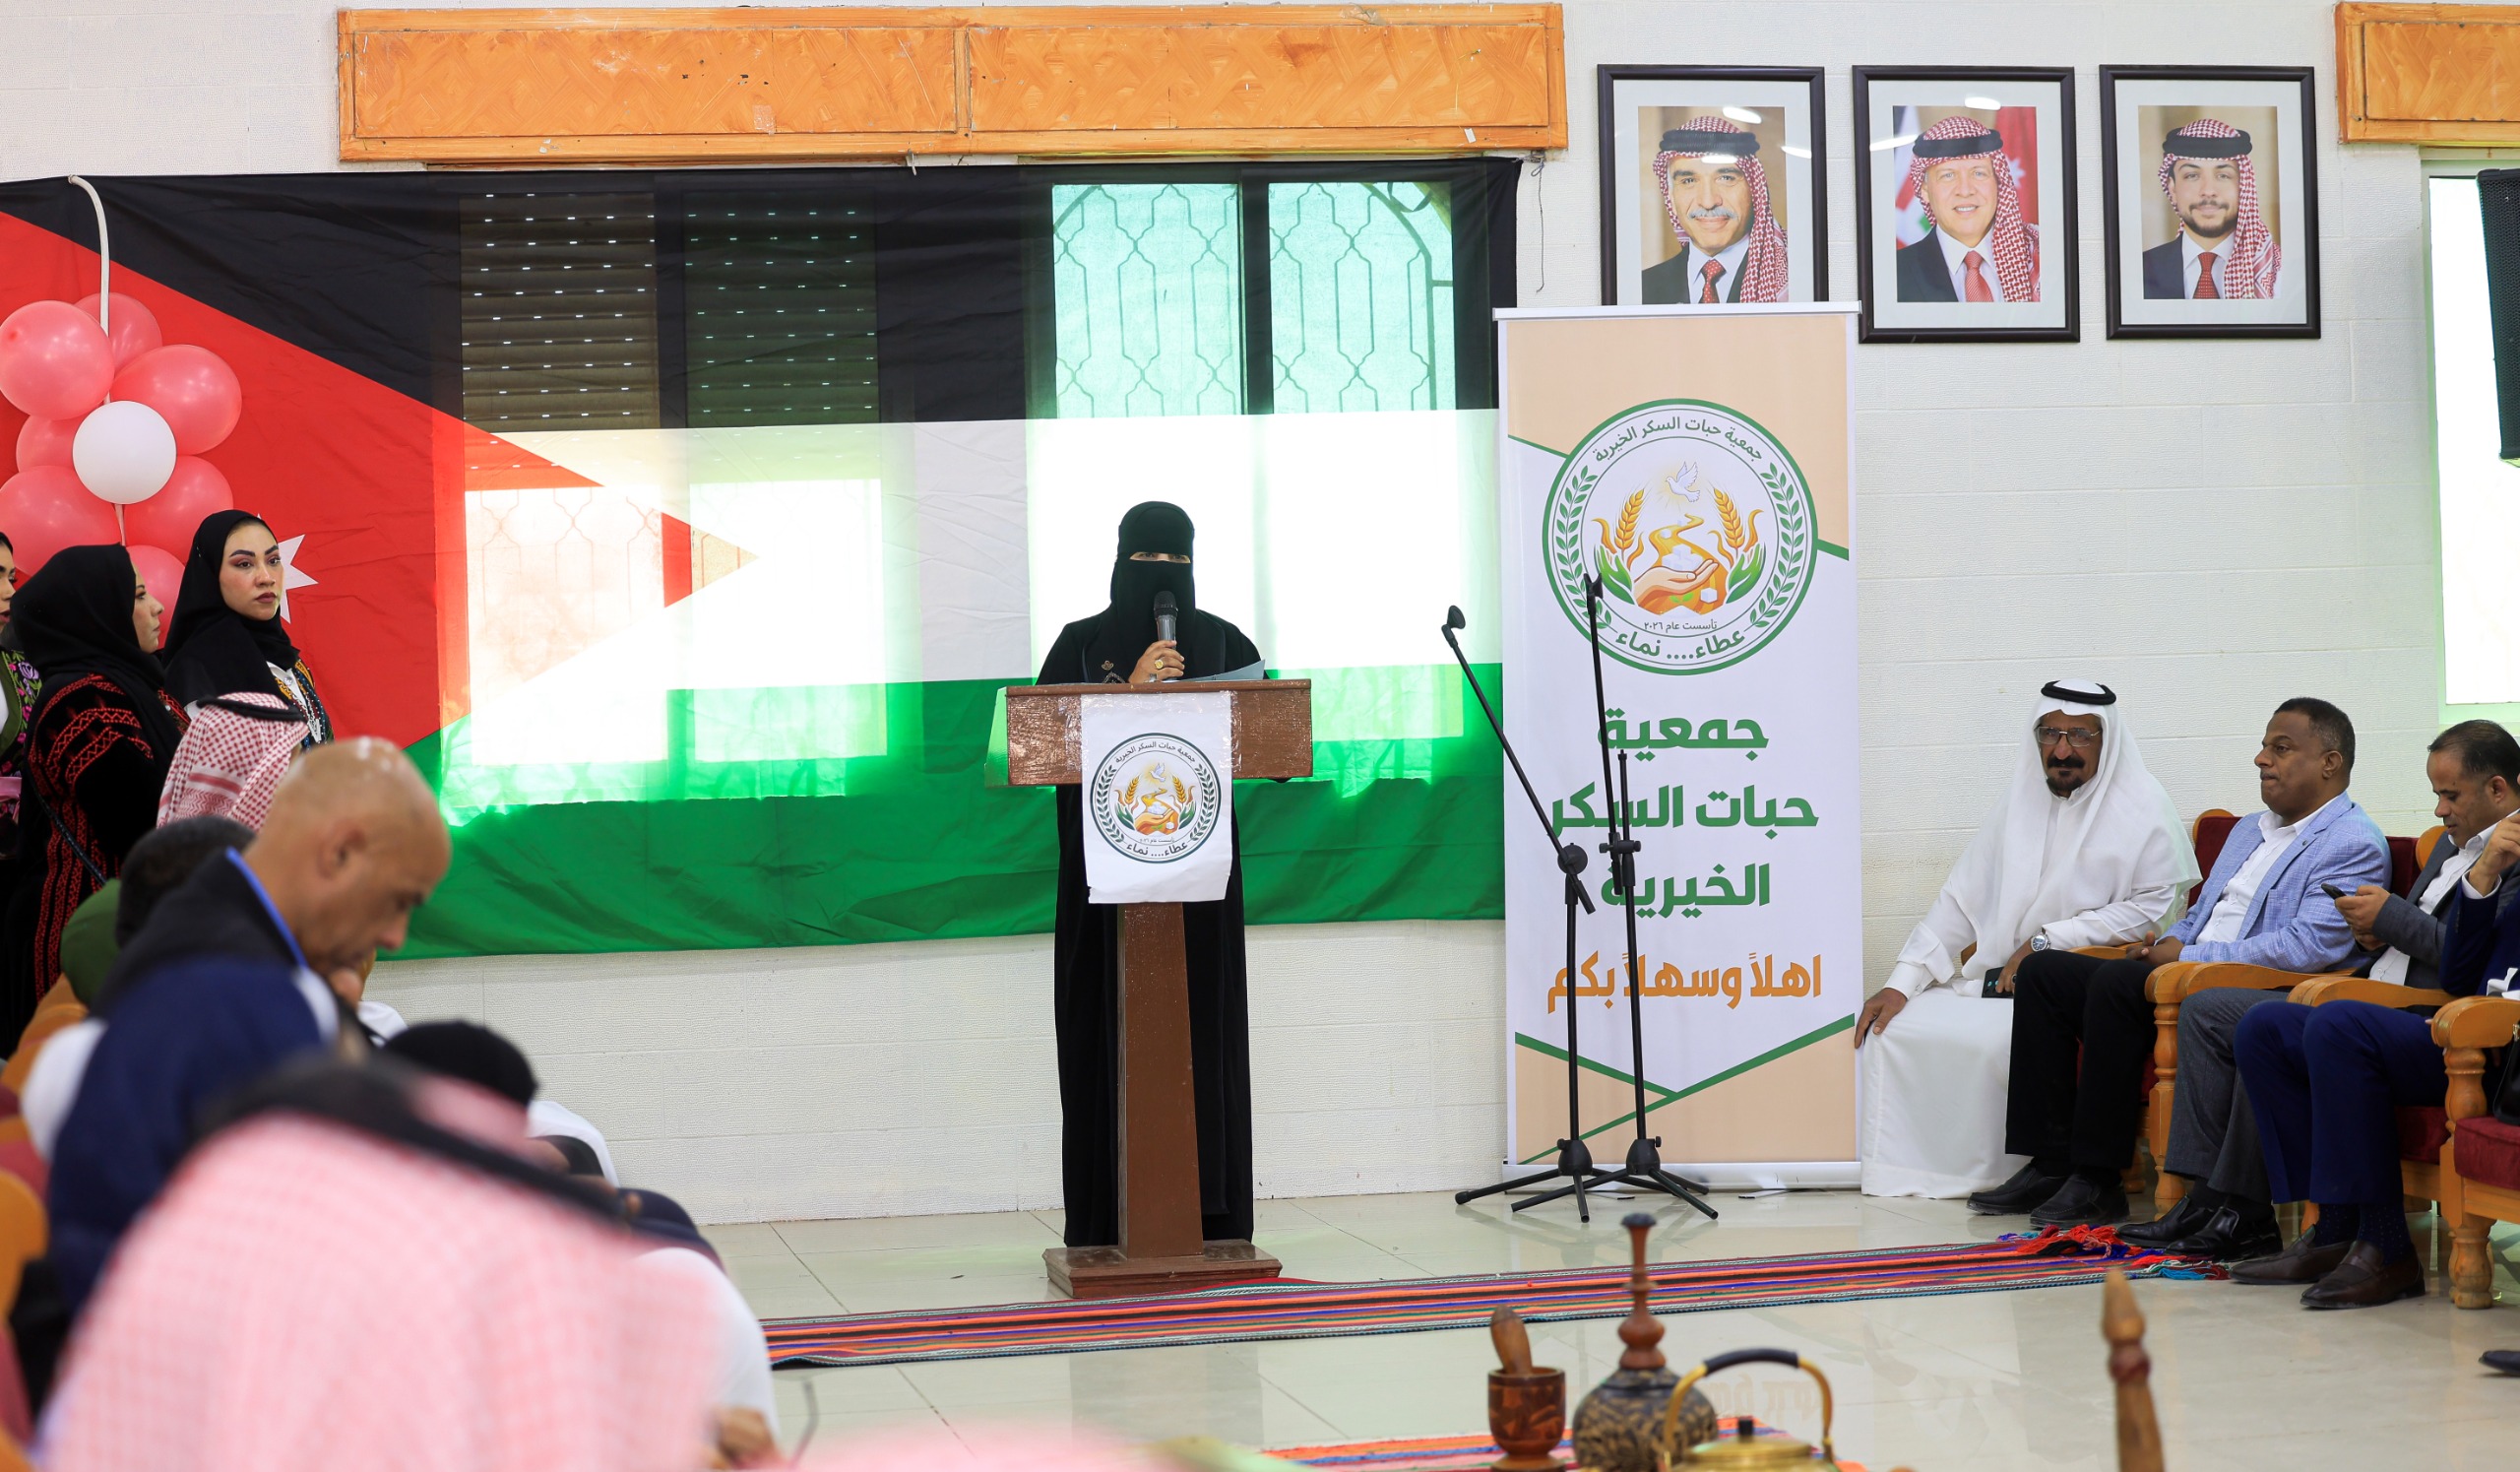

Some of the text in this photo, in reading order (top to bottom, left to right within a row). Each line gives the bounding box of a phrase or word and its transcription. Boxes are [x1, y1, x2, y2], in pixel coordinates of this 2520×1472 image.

[1592, 416, 1762, 462] جمعية حبات السكر الخيرية
[1666, 621, 1679, 633] عام
[1682, 618, 1718, 630] تأسست
[1615, 631, 1661, 657] نماء
[1115, 741, 1196, 763] جمعية حبات السكر الخيرية
[1598, 707, 1769, 762] جمعية
[1546, 781, 1819, 840] حبات السكر
[1126, 843, 1149, 856] نماء
[1601, 863, 1770, 919] الخيرية
[1547, 950, 1615, 1014] بكم
